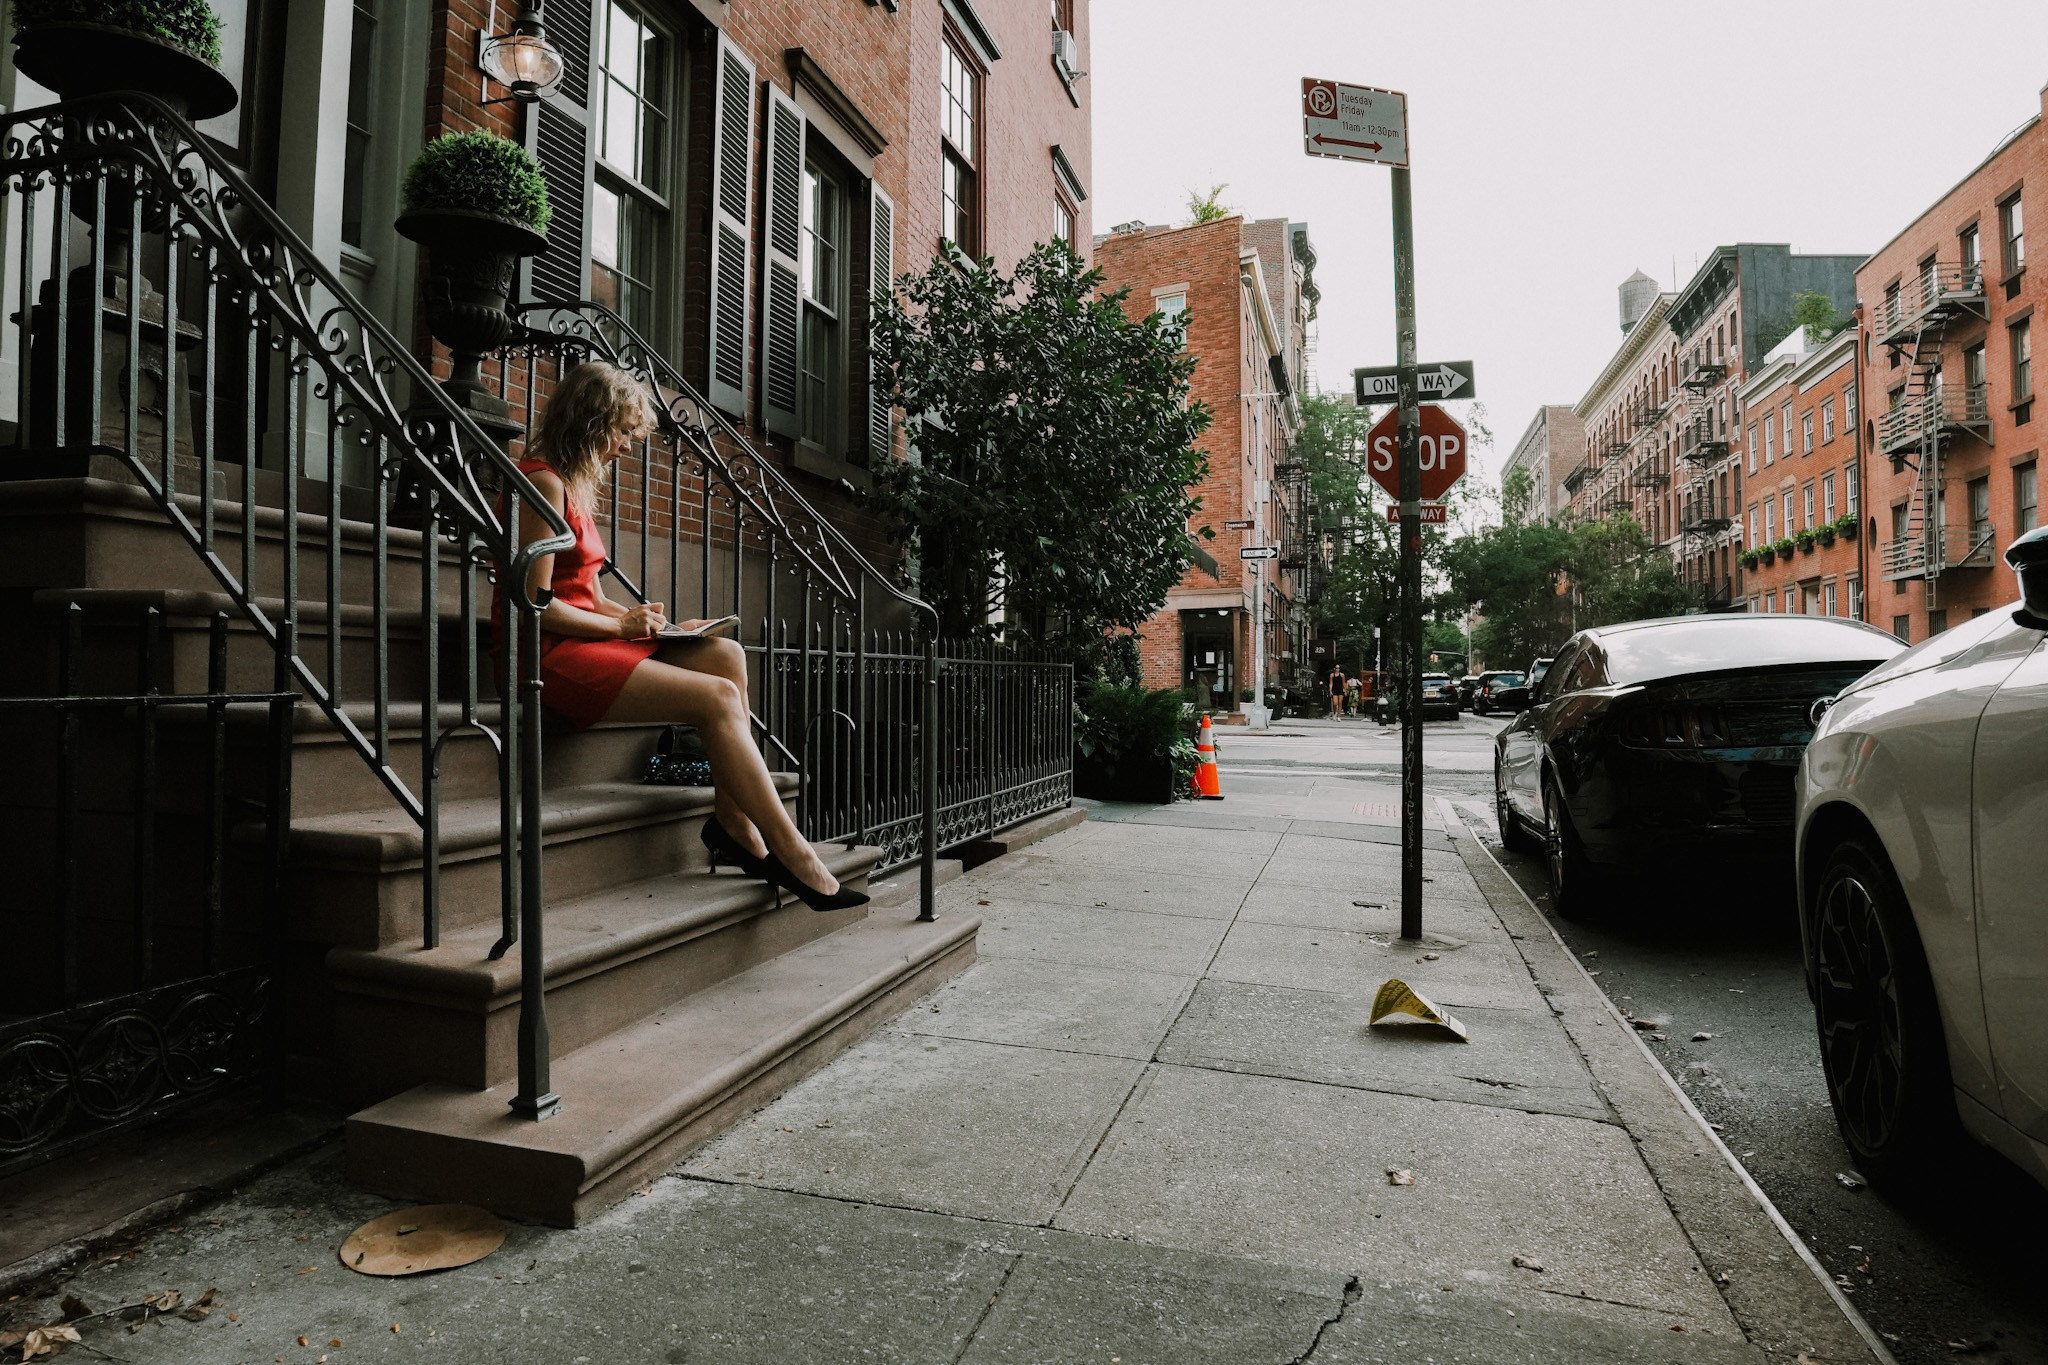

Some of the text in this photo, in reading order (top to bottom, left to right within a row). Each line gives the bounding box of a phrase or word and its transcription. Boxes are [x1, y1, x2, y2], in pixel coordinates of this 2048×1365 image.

[1340, 93, 1372, 107] Tuesday
[1340, 104, 1364, 117] Friday
[1342, 121, 1360, 132] 11am
[1368, 125, 1399, 138] 12:30pm
[1373, 374, 1456, 393] ON WAY
[1373, 435, 1459, 472] SOP
[1420, 508, 1442, 520] WAY
